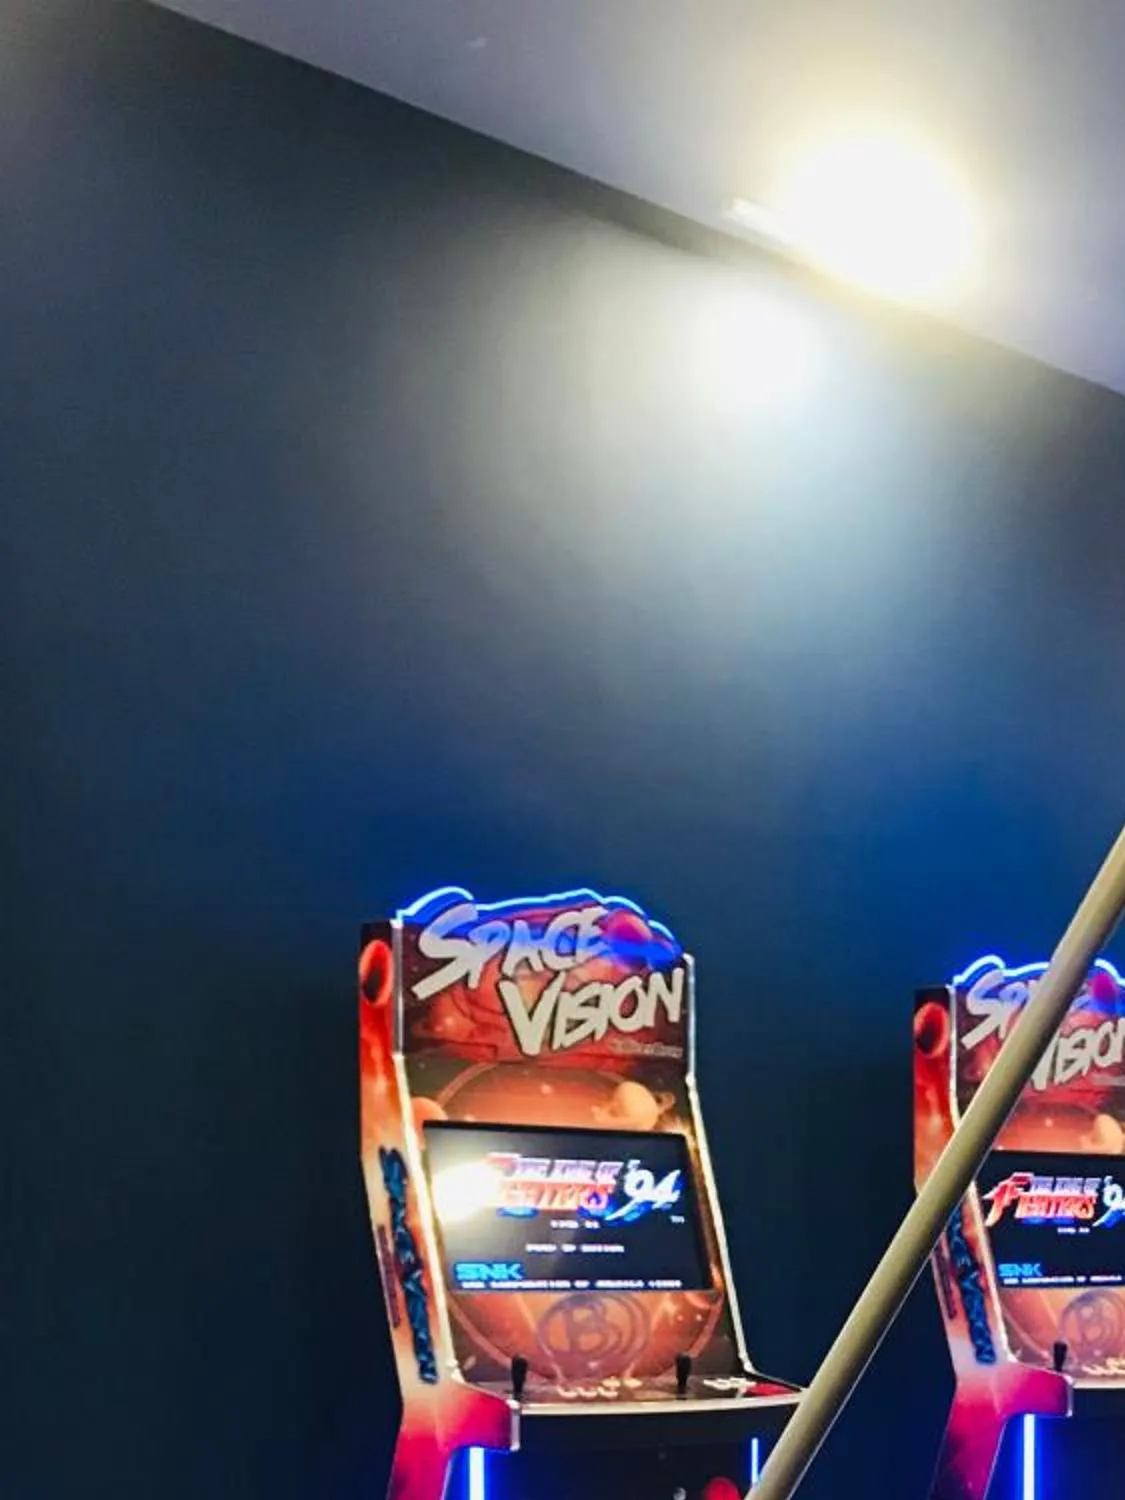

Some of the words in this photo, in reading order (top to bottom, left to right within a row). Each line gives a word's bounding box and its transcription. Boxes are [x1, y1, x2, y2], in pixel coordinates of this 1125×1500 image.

[411, 903, 609, 1000] SPACE
[499, 967, 685, 1056] VISION
[456, 1263, 523, 1280] SNK
[998, 1263, 1042, 1277] SNK
